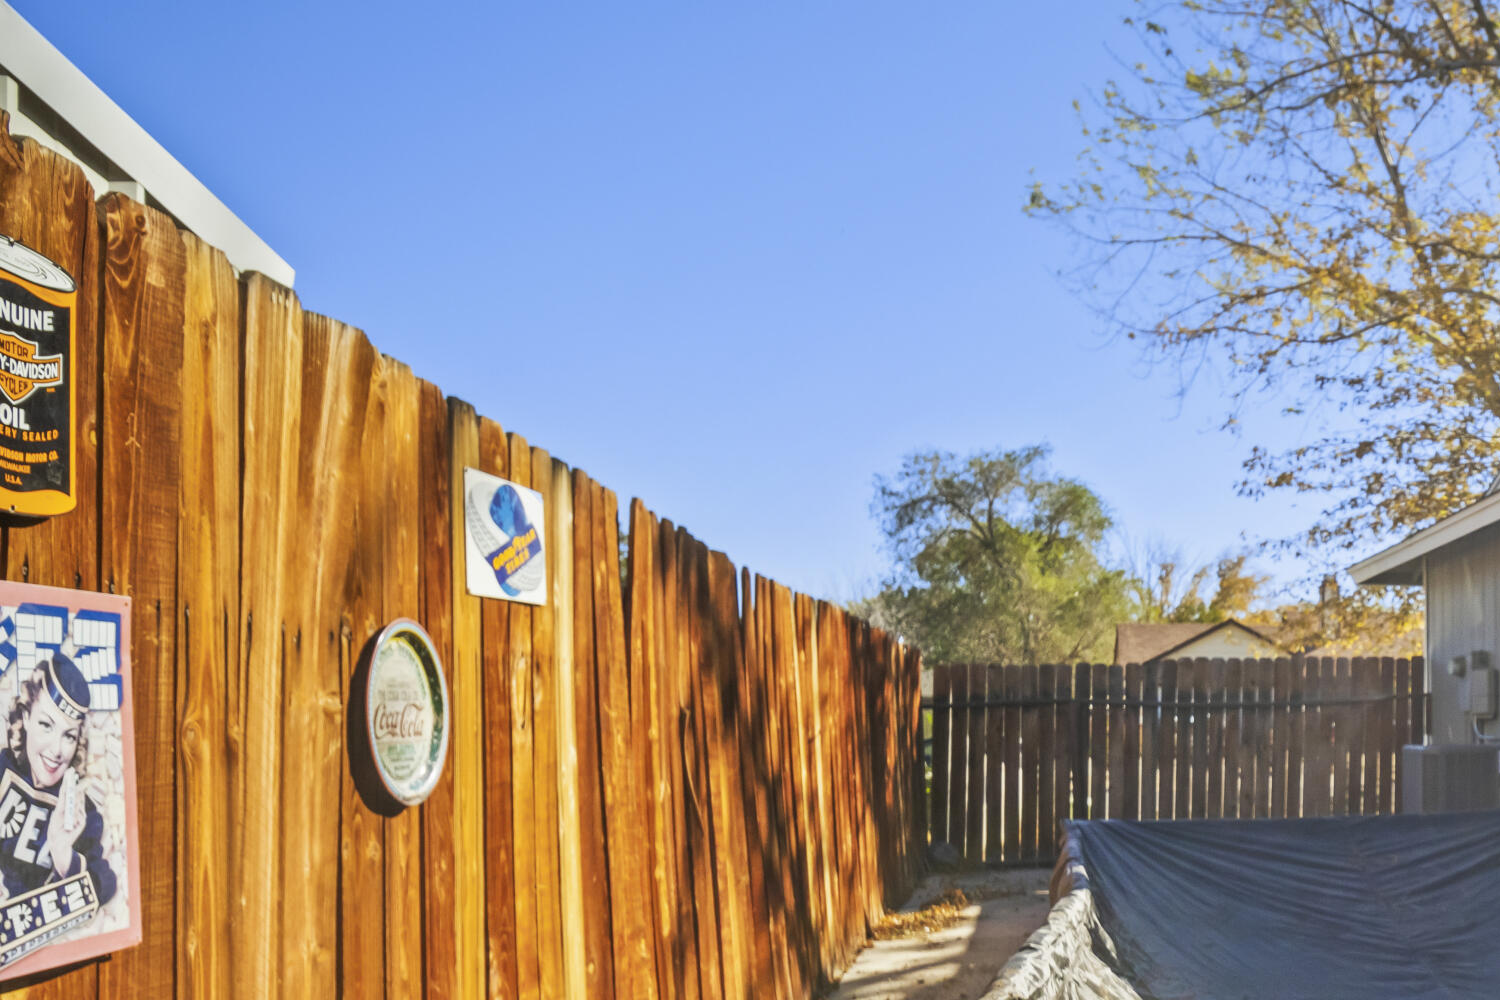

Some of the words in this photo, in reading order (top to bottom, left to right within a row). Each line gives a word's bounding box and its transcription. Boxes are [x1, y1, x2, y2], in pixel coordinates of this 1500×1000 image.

[0, 403, 30, 430] OIL
[22, 428, 59, 442] SEALED
[0, 612, 119, 711] EZ
[6, 880, 86, 938] PEZ
